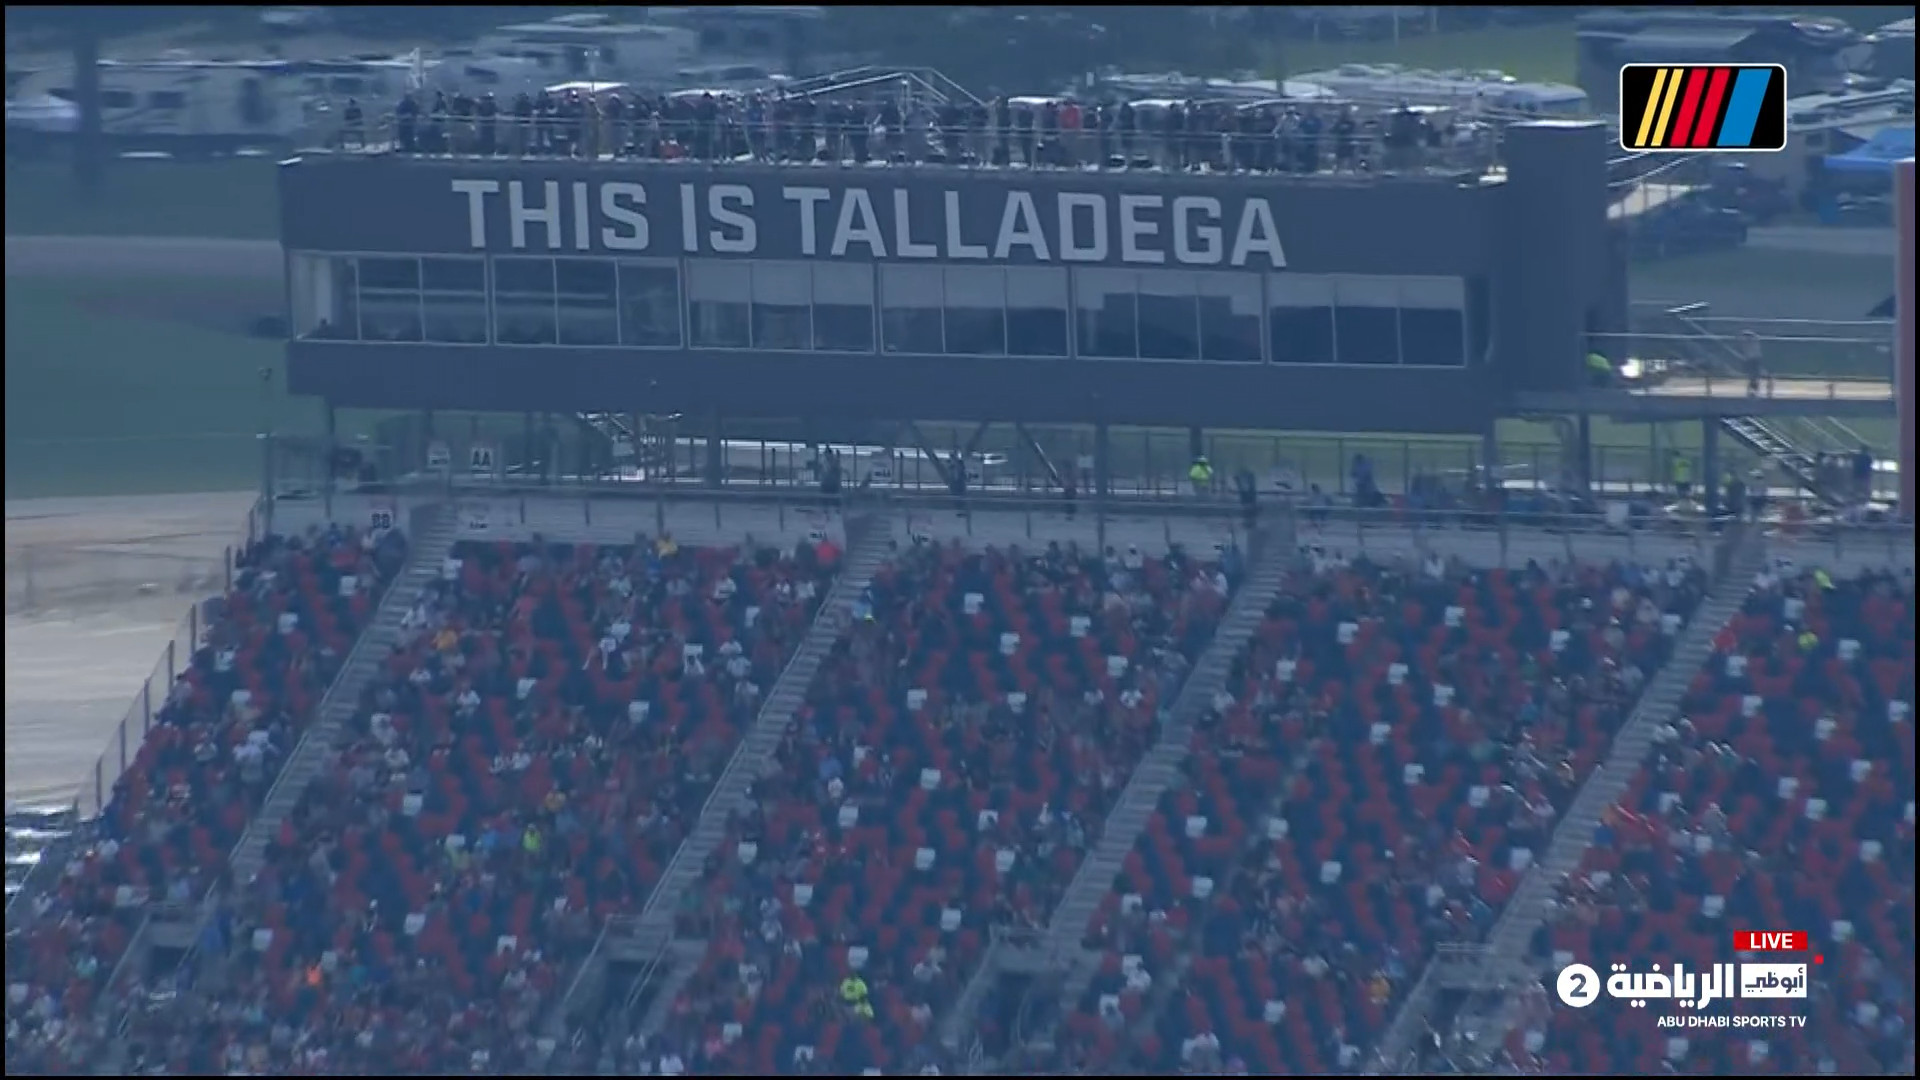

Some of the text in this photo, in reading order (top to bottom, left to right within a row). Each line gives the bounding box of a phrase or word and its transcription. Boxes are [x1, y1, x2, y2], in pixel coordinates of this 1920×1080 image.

[451, 179, 1288, 267] THIS IS TALLADEGA
[472, 449, 491, 466] AA
